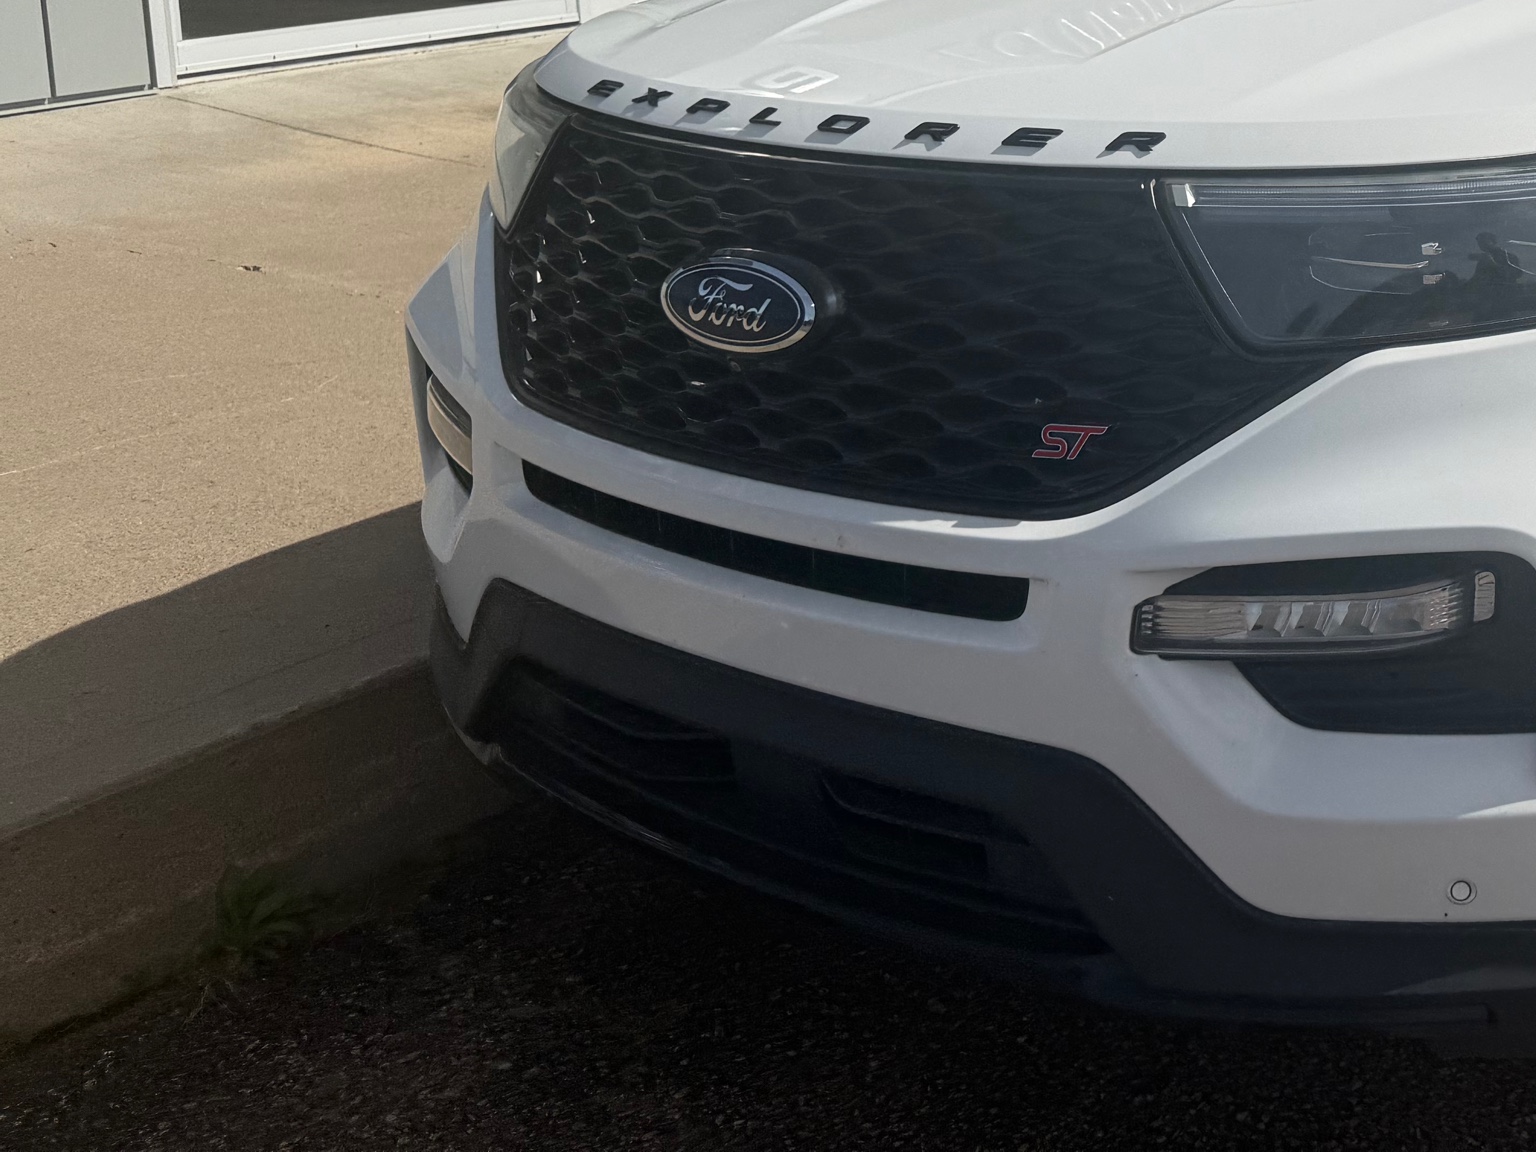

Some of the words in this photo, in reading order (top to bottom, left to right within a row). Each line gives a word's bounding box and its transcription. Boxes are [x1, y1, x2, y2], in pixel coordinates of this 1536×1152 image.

[587, 79, 1167, 152] EXPLORER
[688, 276, 768, 333] Ford
[1032, 423, 1109, 461] ST
